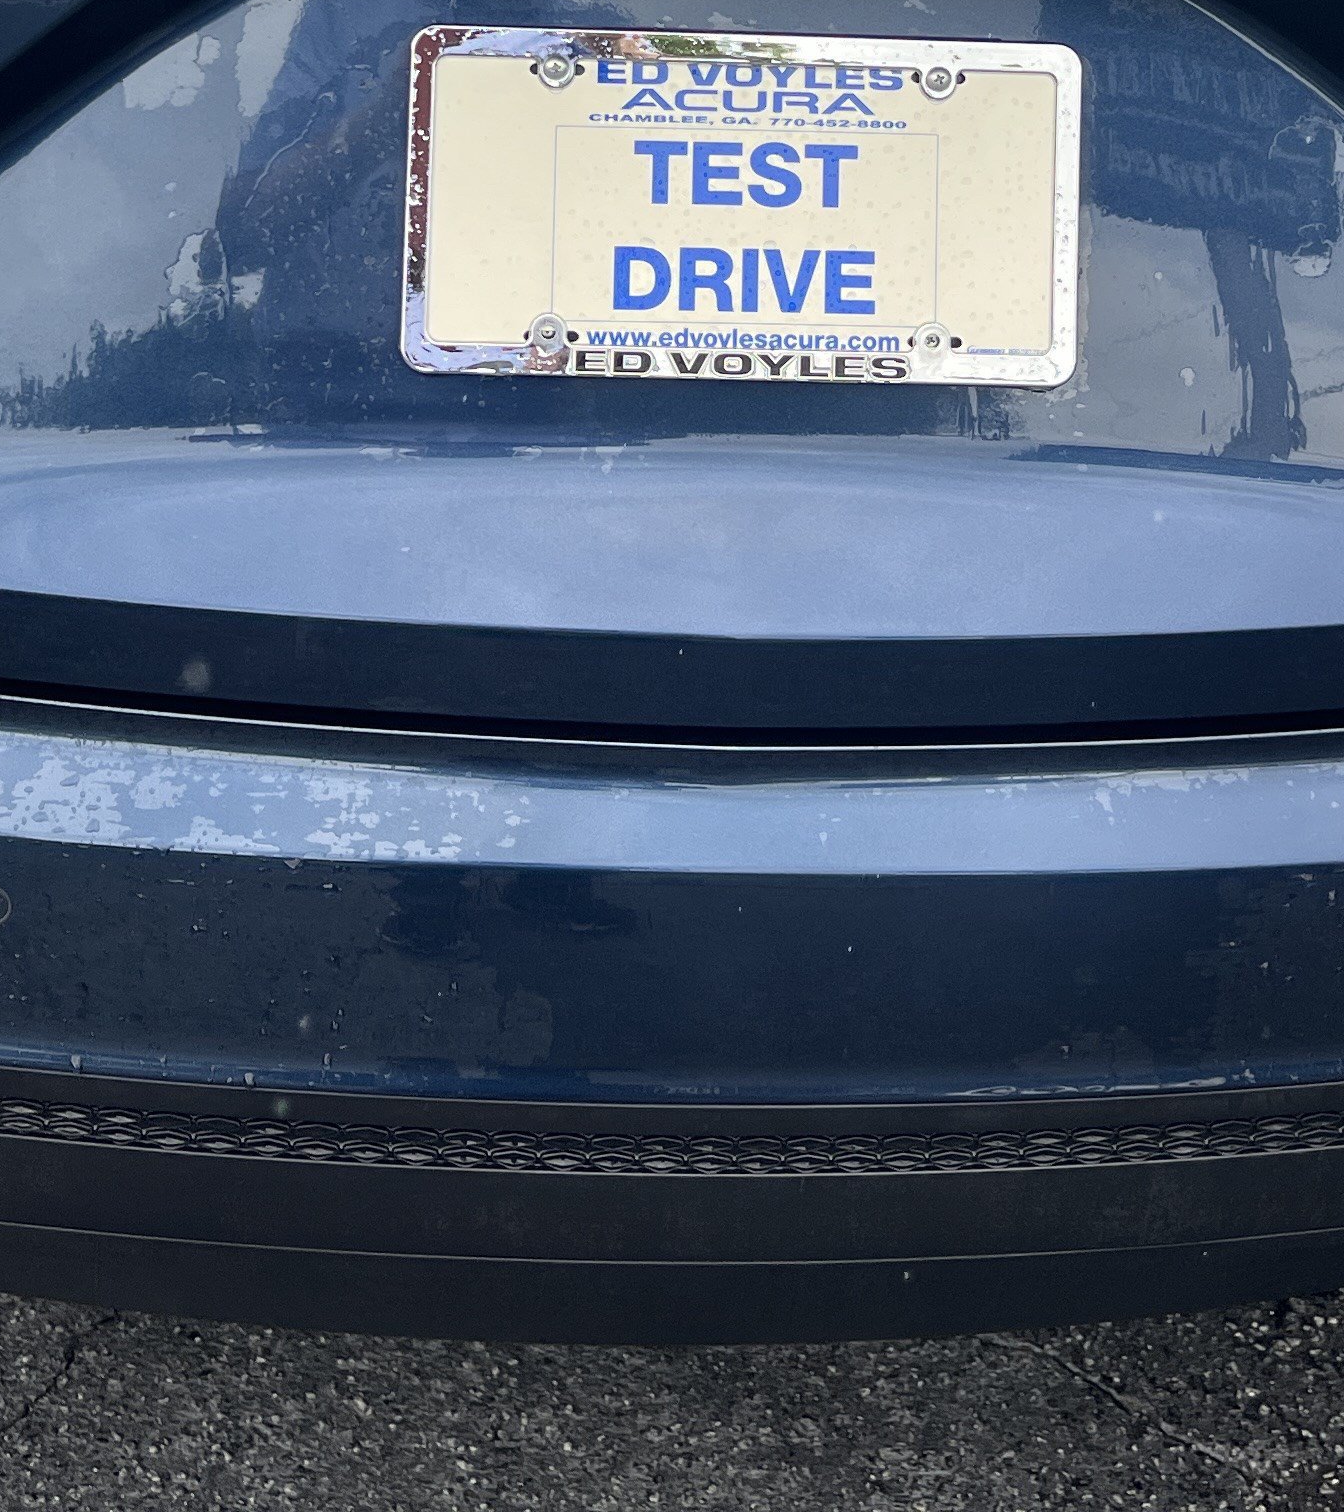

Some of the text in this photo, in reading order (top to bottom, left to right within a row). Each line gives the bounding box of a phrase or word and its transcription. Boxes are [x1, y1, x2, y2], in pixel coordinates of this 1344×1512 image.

[597, 59, 904, 91] ED VOYLES
[621, 88, 875, 116] ACURA
[589, 113, 715, 125] CHAMBLEE,
[769, 117, 907, 130] 770-452-8800
[634, 140, 859, 209] TEST
[612, 245, 876, 315] DRIVE
[586, 328, 901, 353] www.edvoylesacura.com
[574, 350, 910, 381] ED VOYLES
